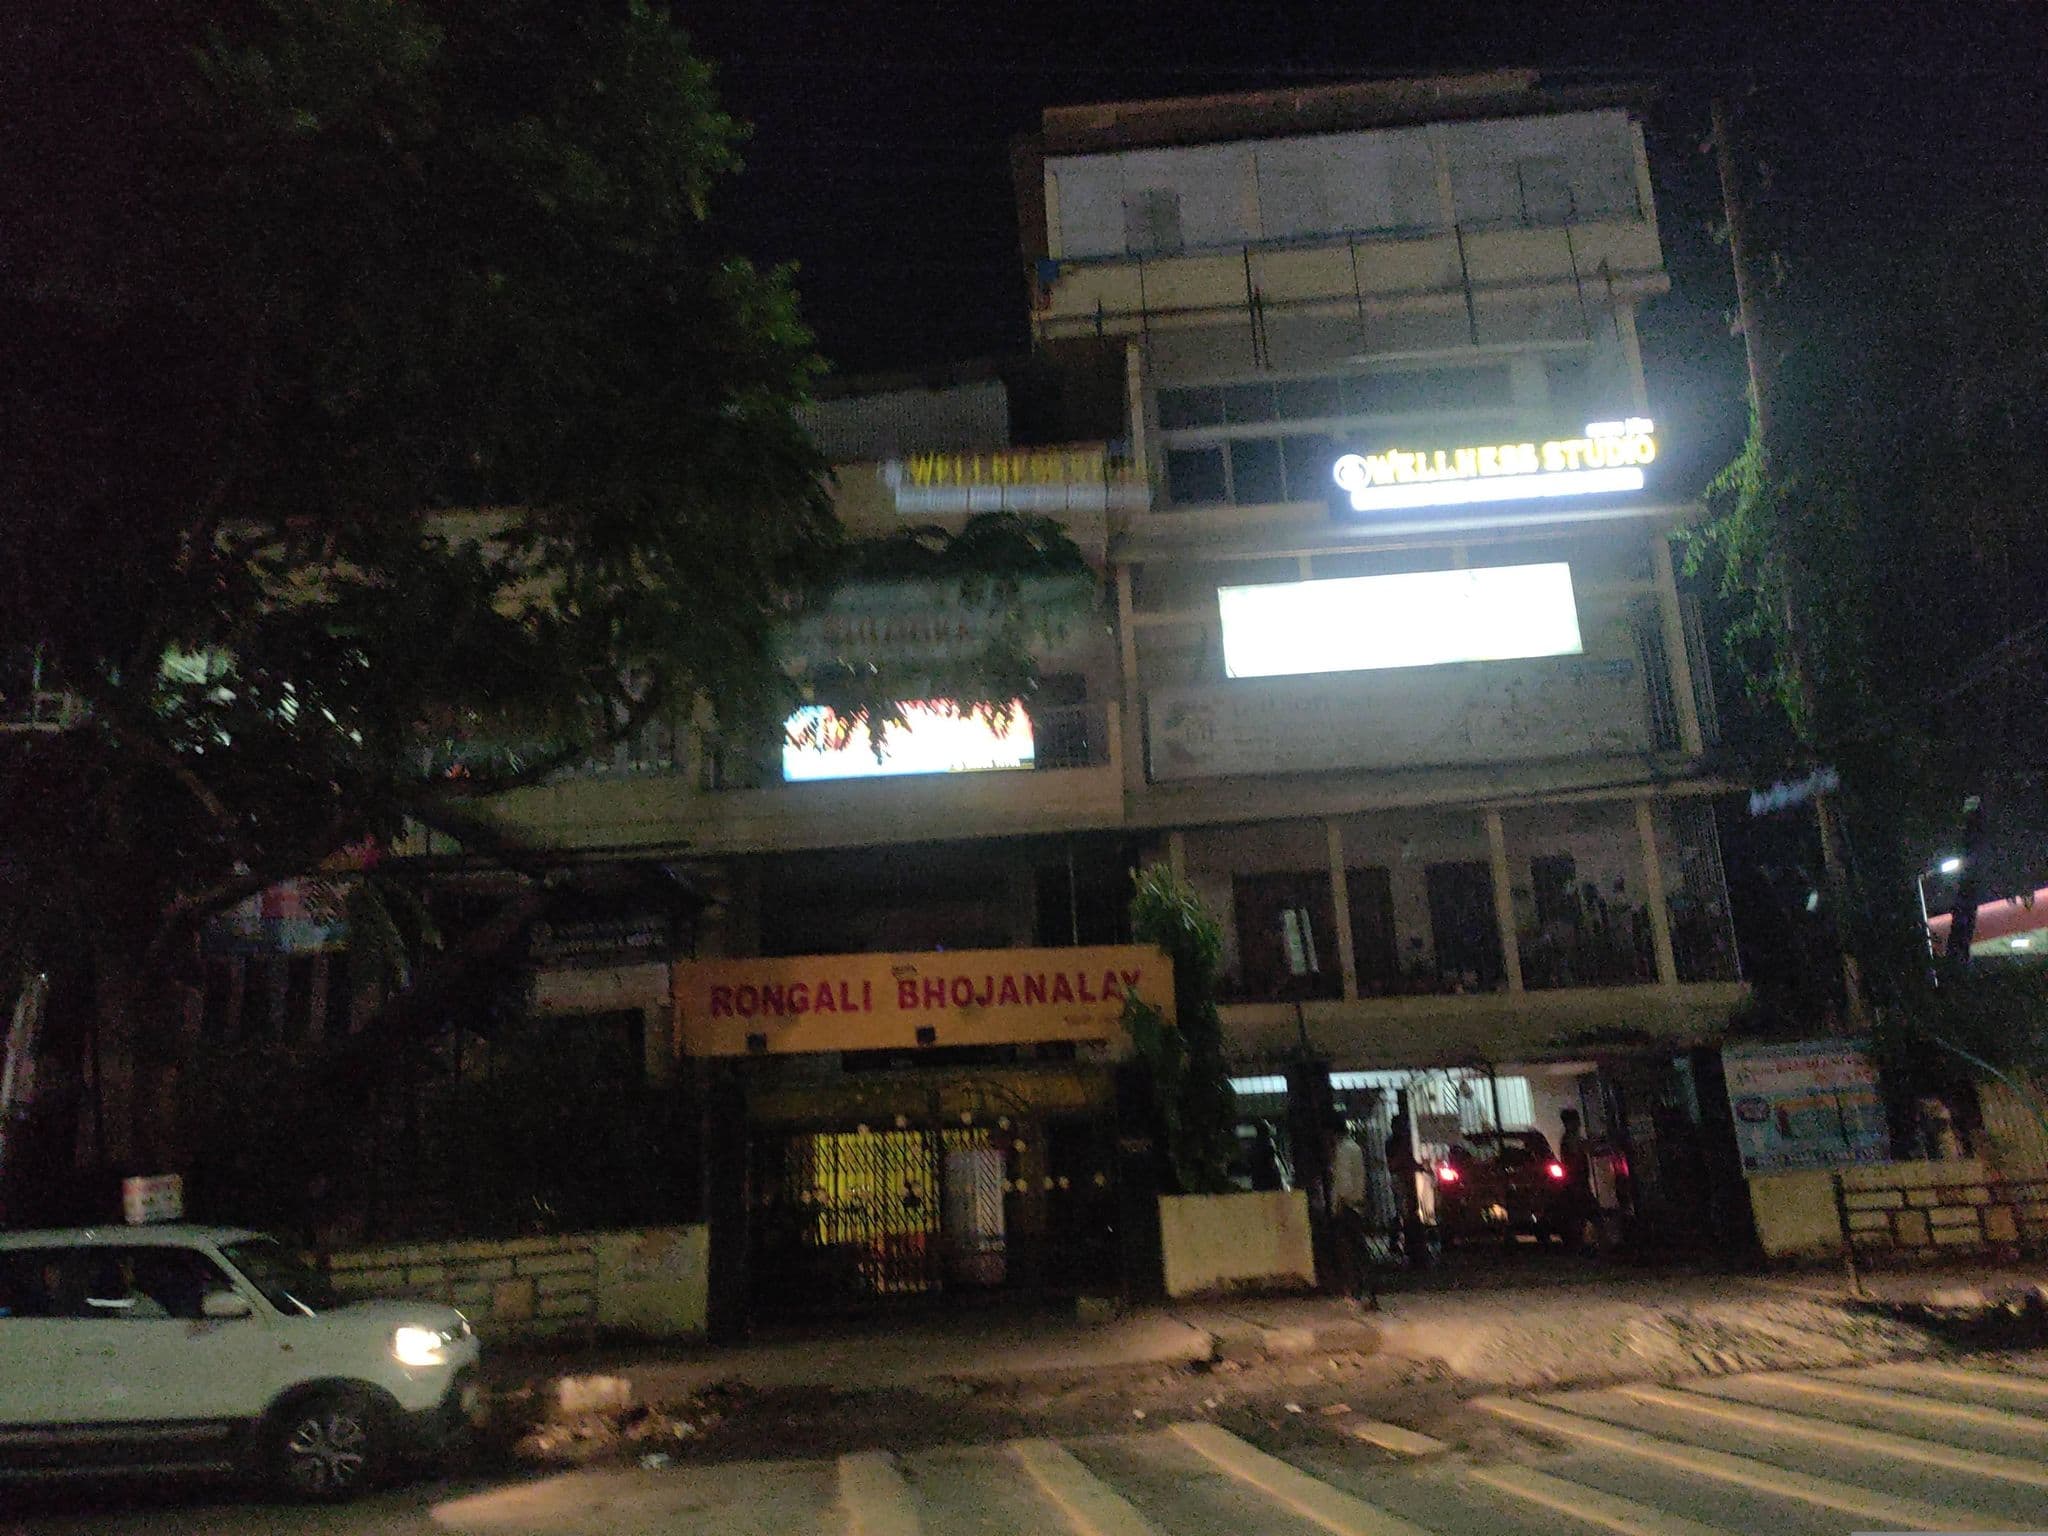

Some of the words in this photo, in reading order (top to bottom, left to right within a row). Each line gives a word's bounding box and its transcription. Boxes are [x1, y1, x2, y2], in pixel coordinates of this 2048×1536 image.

[1367, 443, 1539, 486] WELLNESS
[1541, 434, 1656, 472] STUDIO
[711, 979, 873, 1018] RONGALI
[898, 965, 1142, 1010] BHOJANALAY
